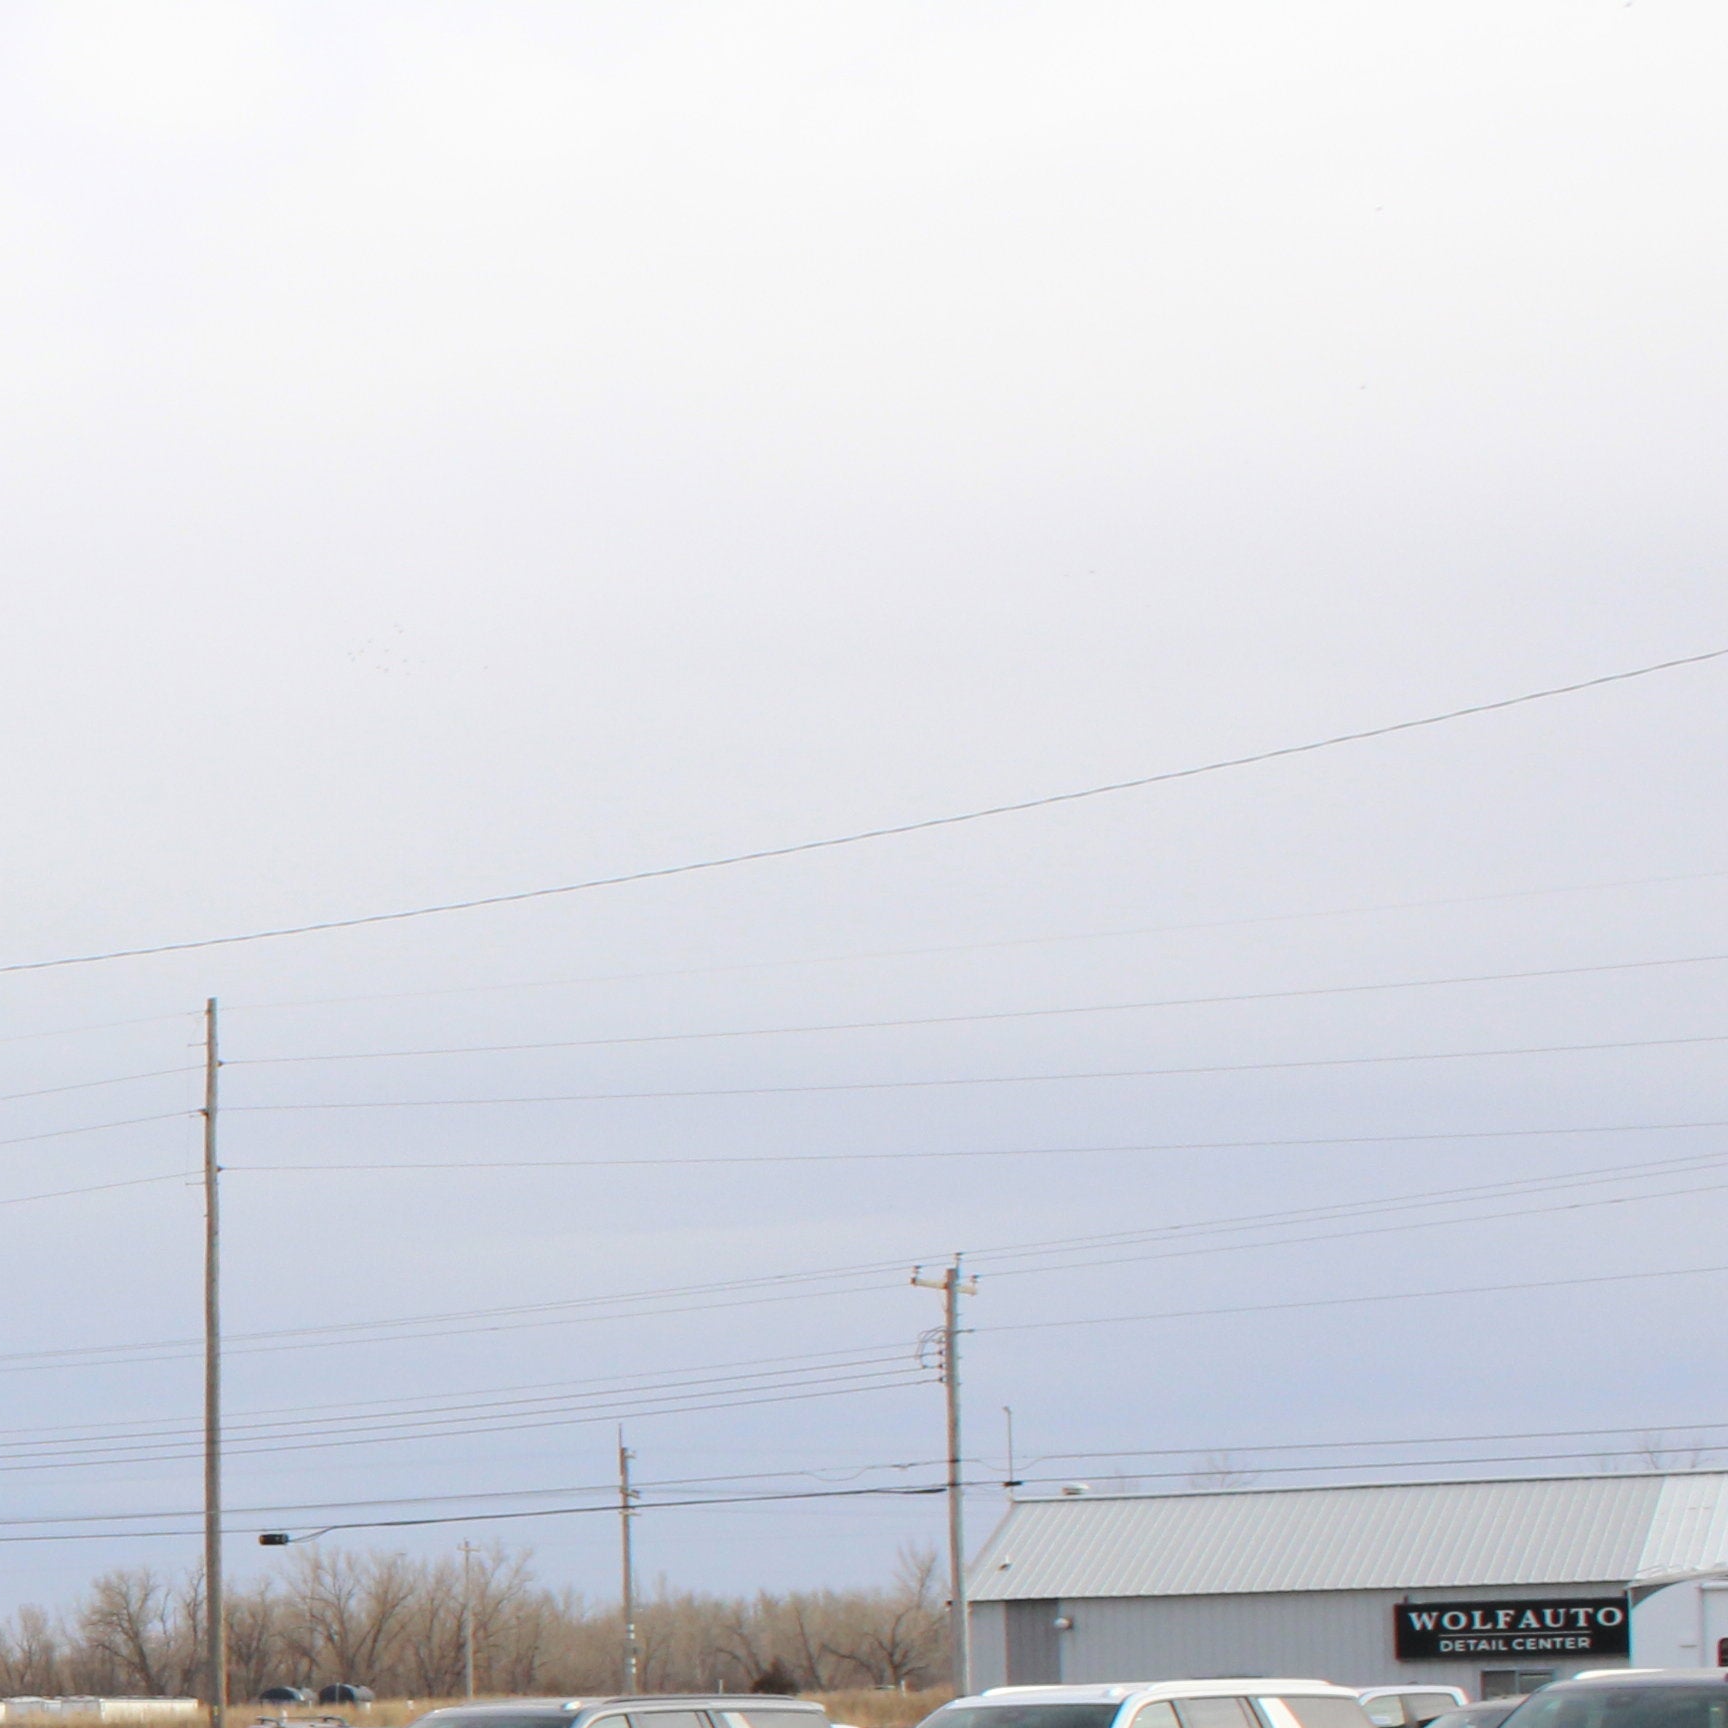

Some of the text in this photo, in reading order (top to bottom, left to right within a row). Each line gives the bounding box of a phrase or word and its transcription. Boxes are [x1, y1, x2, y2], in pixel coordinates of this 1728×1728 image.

[1408, 1606, 1624, 1631] WOLFAUTO
[1439, 1636, 1591, 1652] DETAIL CENTER
